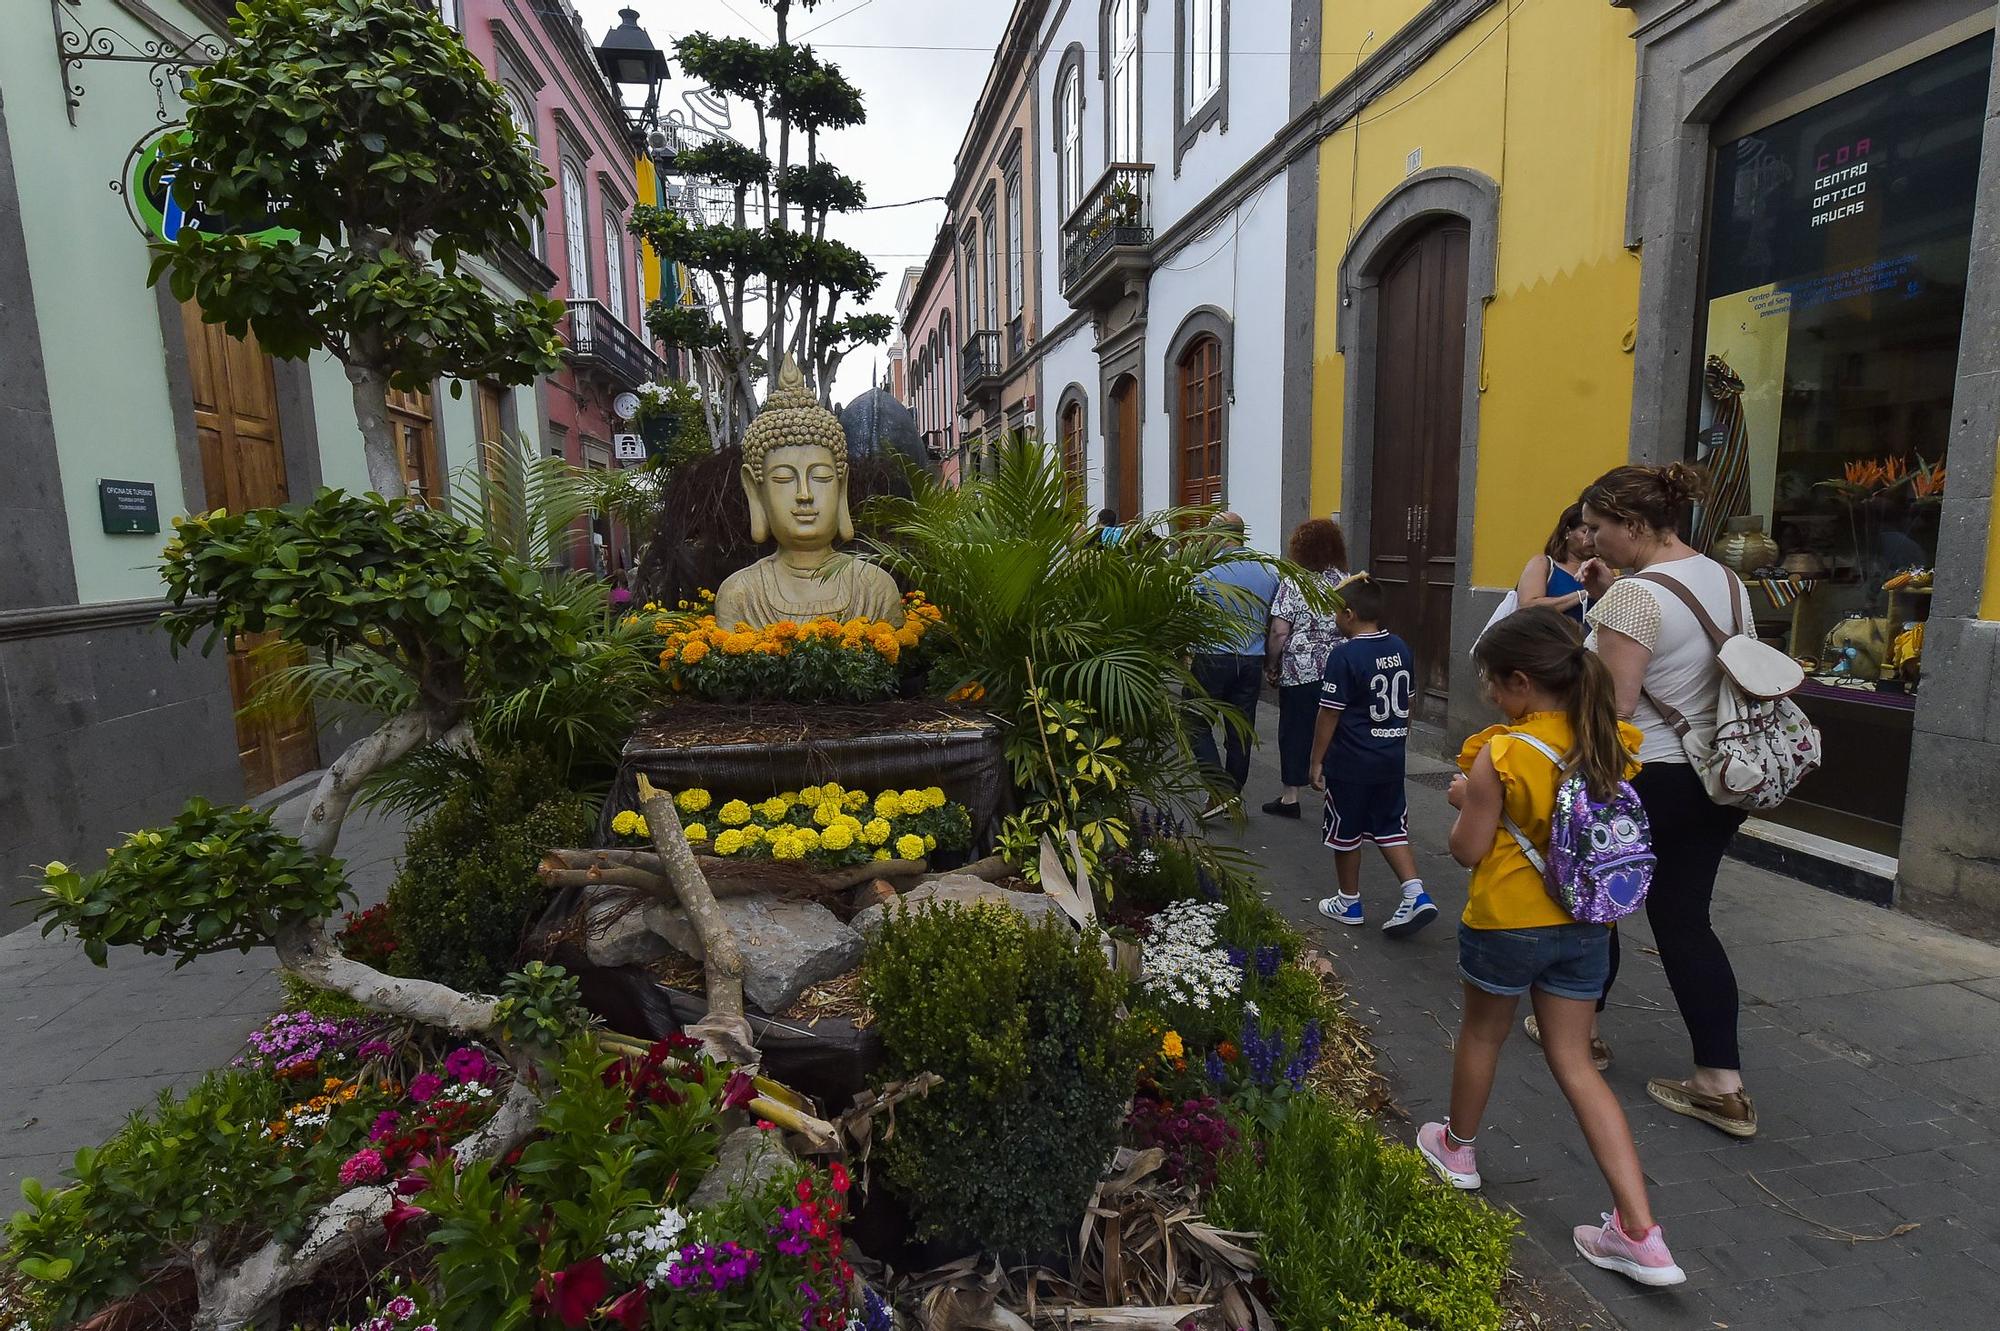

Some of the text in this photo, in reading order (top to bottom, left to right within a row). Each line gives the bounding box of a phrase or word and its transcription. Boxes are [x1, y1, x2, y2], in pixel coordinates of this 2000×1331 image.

[1814, 162, 1869, 191] CENTRO
[1812, 181, 1867, 209] OPTICO
[1811, 201, 1865, 228] ARUCAS
[1376, 653, 1402, 670] MESSI
[1369, 670, 1410, 722] 30
